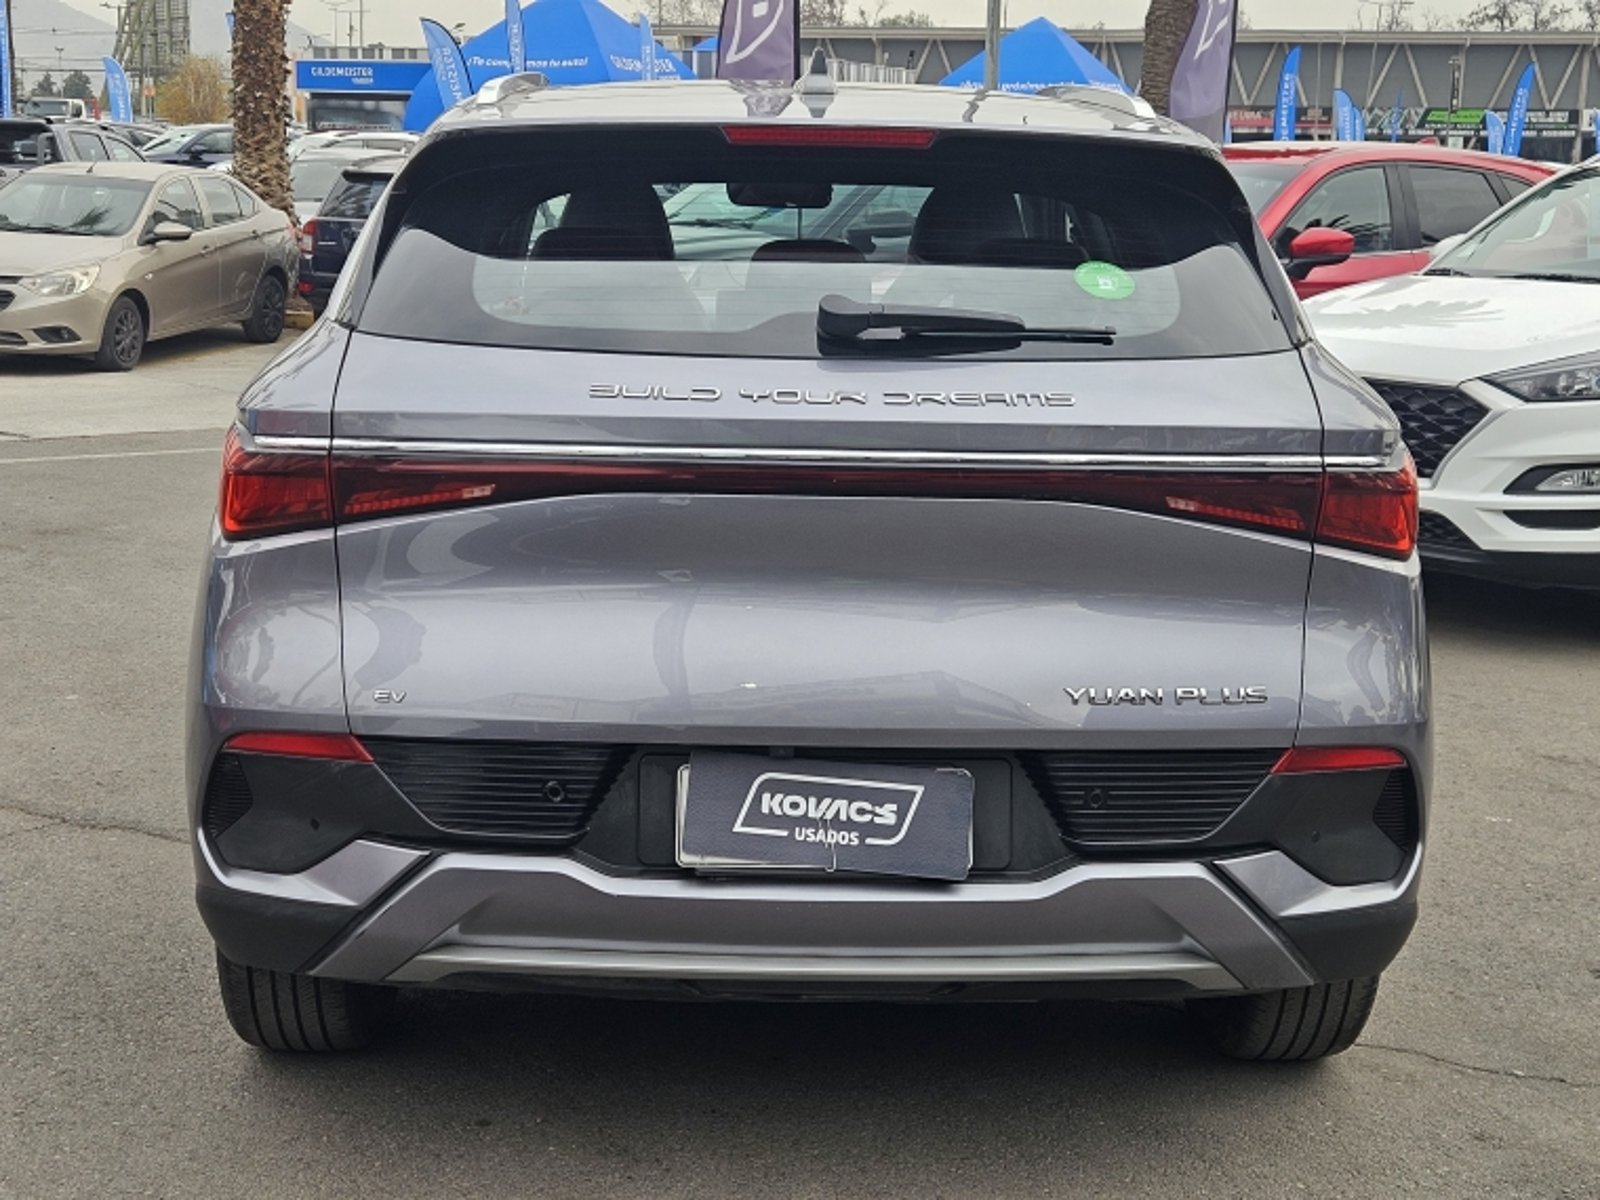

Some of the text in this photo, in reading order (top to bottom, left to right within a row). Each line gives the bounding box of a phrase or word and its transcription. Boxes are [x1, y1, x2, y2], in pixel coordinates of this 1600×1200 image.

[311, 66, 374, 77] GILDEMEISTER
[589, 384, 1077, 408] BUILD YOUR DREAMS
[373, 689, 407, 704] EV
[1064, 685, 1269, 706] YUAN PLUS
[761, 792, 898, 826] KOVACS
[794, 826, 860, 846] USADOS
